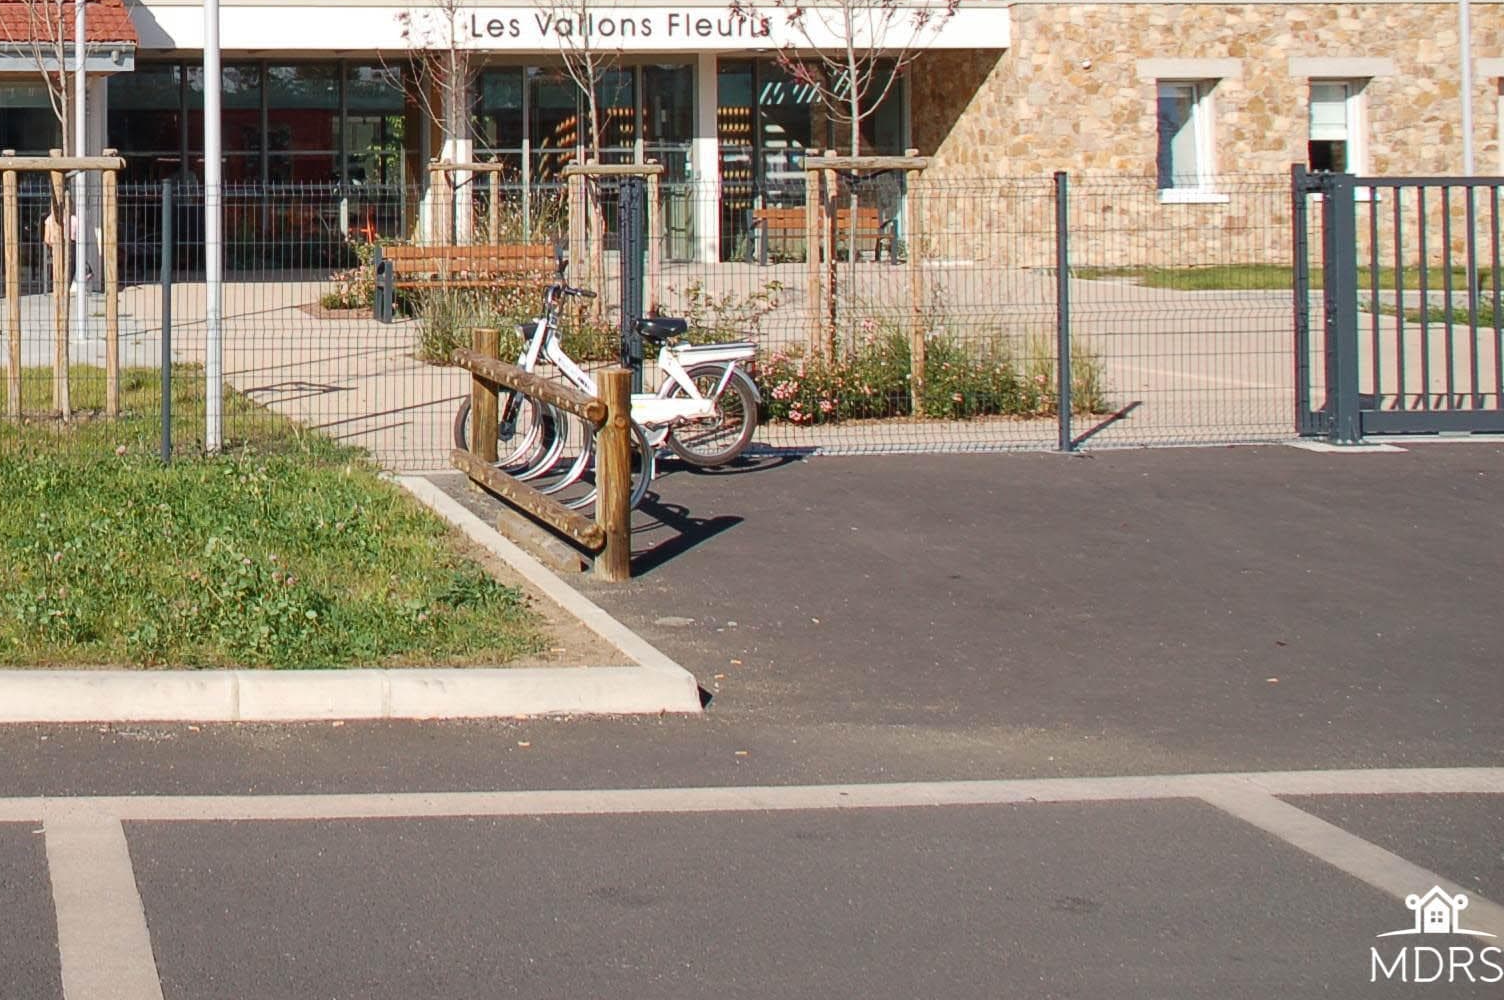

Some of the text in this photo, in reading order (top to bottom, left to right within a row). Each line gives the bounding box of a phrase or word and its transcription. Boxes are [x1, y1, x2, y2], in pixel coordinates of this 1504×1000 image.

[470, 13, 770, 37] Les Vallons Fleuris
